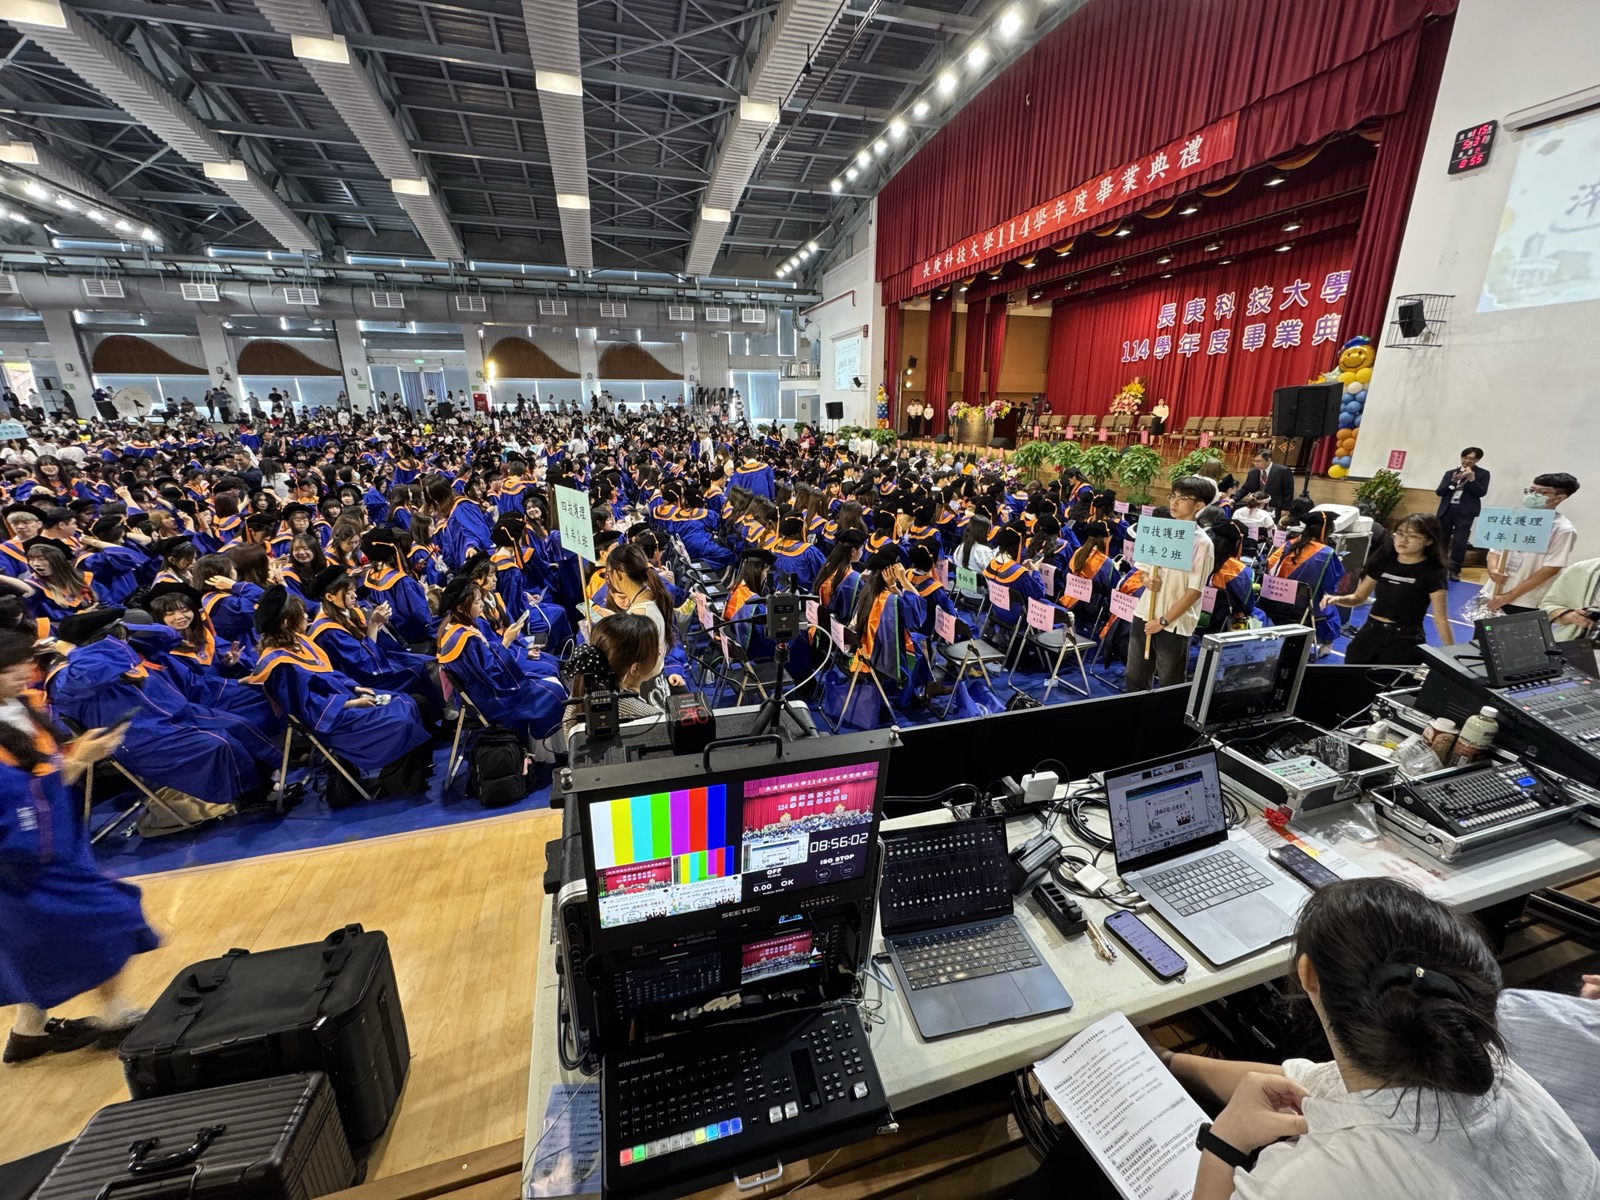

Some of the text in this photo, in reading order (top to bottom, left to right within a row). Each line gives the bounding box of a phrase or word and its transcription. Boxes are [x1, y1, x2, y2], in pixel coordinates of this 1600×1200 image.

[922, 134, 1204, 278] 長庚科技大學114學年度畢業典禮
[1157, 270, 1351, 329] 長庚科技大學
[1487, 515, 1543, 527] 四技護理
[1142, 525, 1186, 540] 四技護理
[1483, 531, 1537, 545] 4年1班
[1139, 543, 1183, 561] 4年2班
[809, 832, 869, 854] 08:56:02
[766, 867, 782, 875] OFF
[753, 878, 794, 892] 0.00 OK
[721, 906, 760, 919] SEETEC
